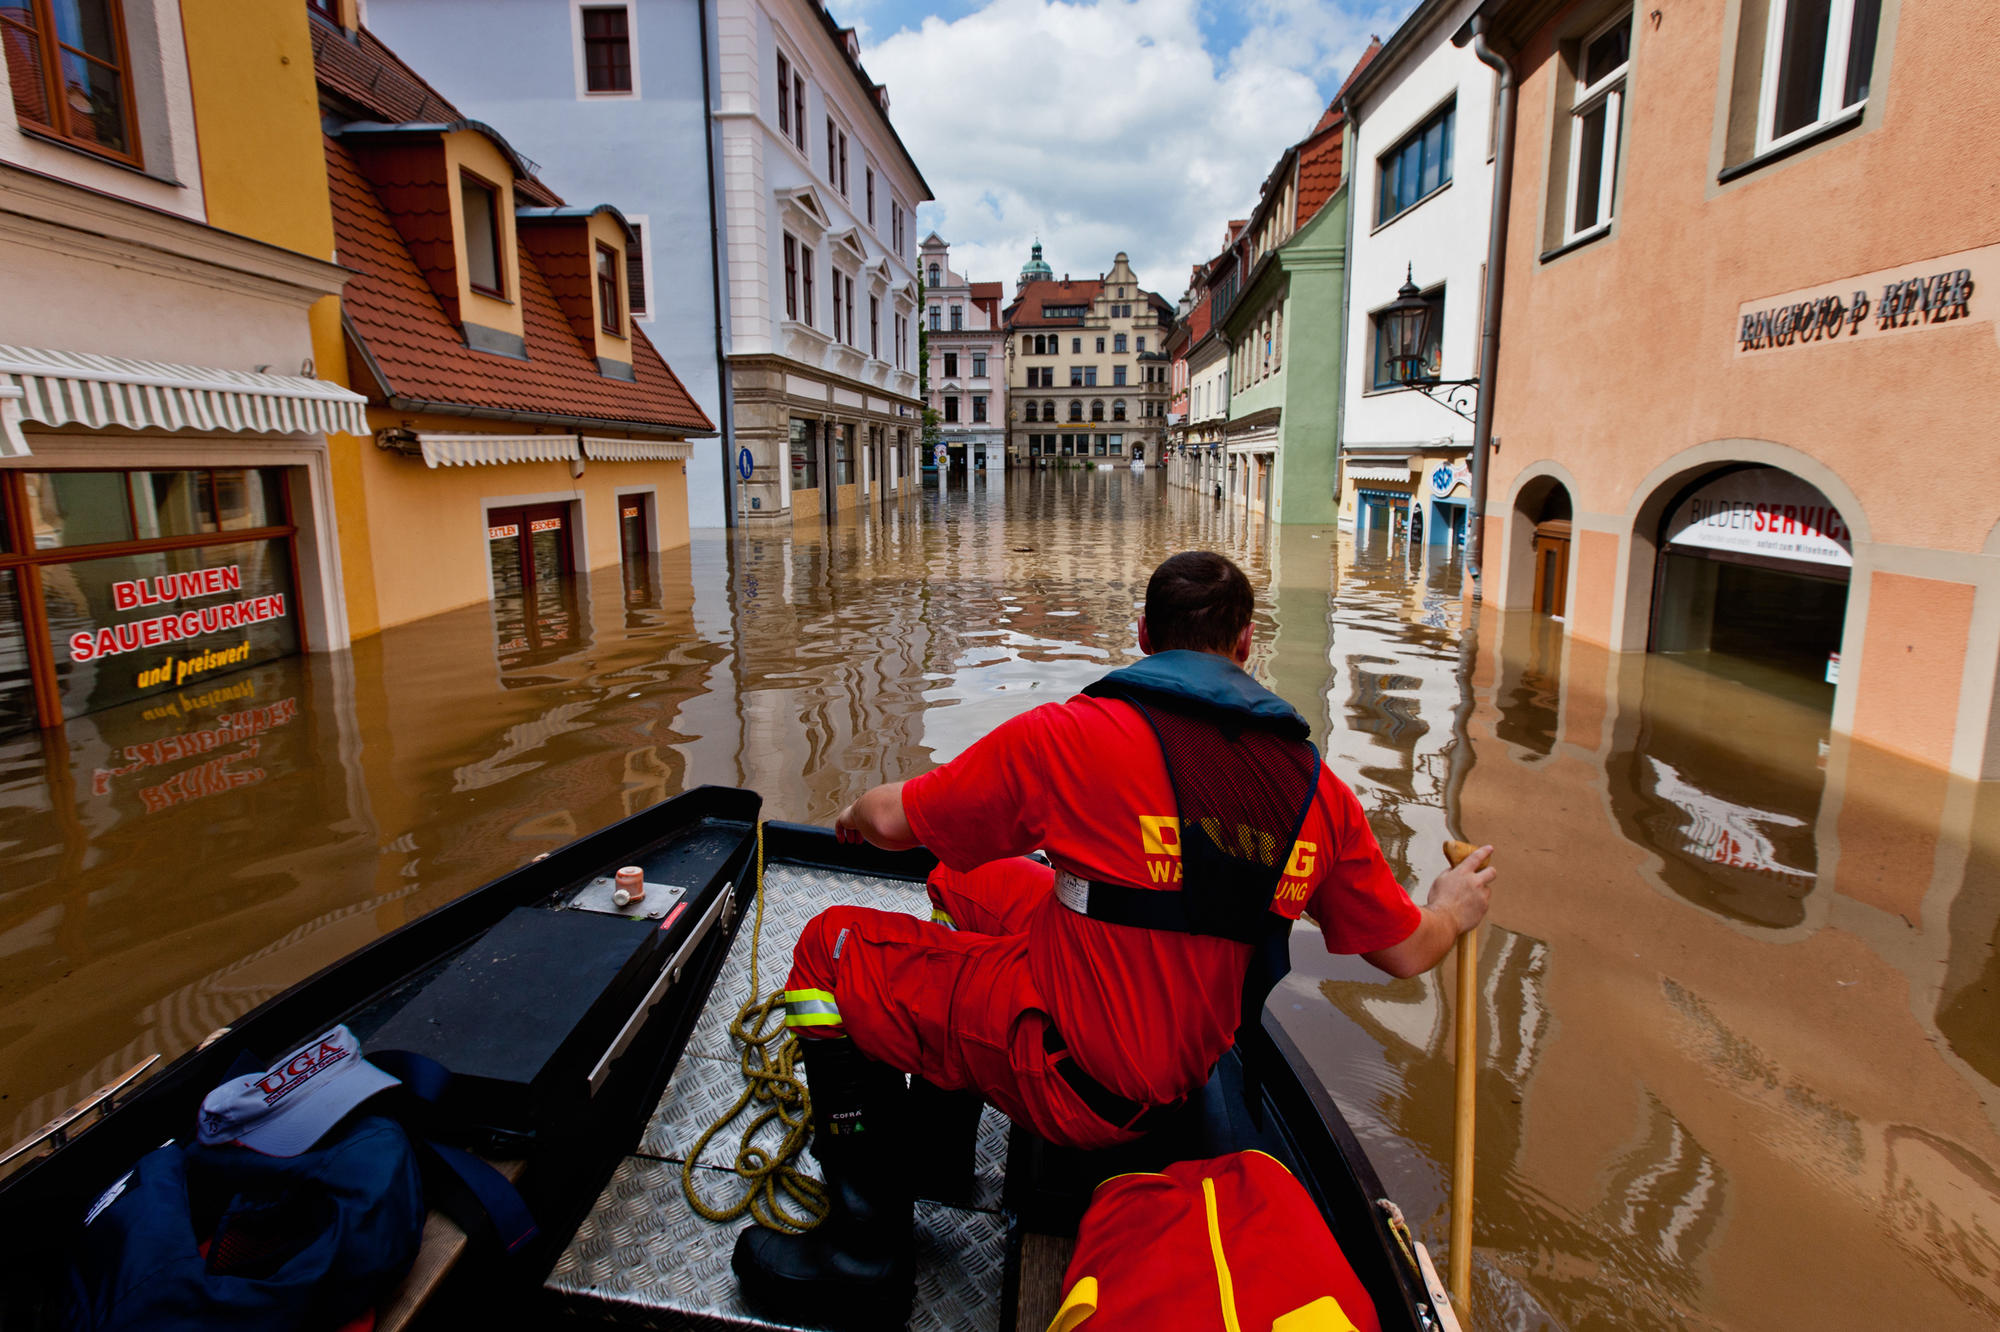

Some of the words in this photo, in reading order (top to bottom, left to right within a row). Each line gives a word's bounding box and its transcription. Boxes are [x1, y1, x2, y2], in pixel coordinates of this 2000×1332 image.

[112, 564, 242, 612] BLUMEN
[69, 592, 286, 663] SAUERGURKEN
[137, 656, 173, 688] und
[176, 640, 250, 686] preiswert
[256, 1043, 342, 1094] UGA
[265, 1073, 309, 1104] University
[833, 1110, 862, 1119] COFRA
